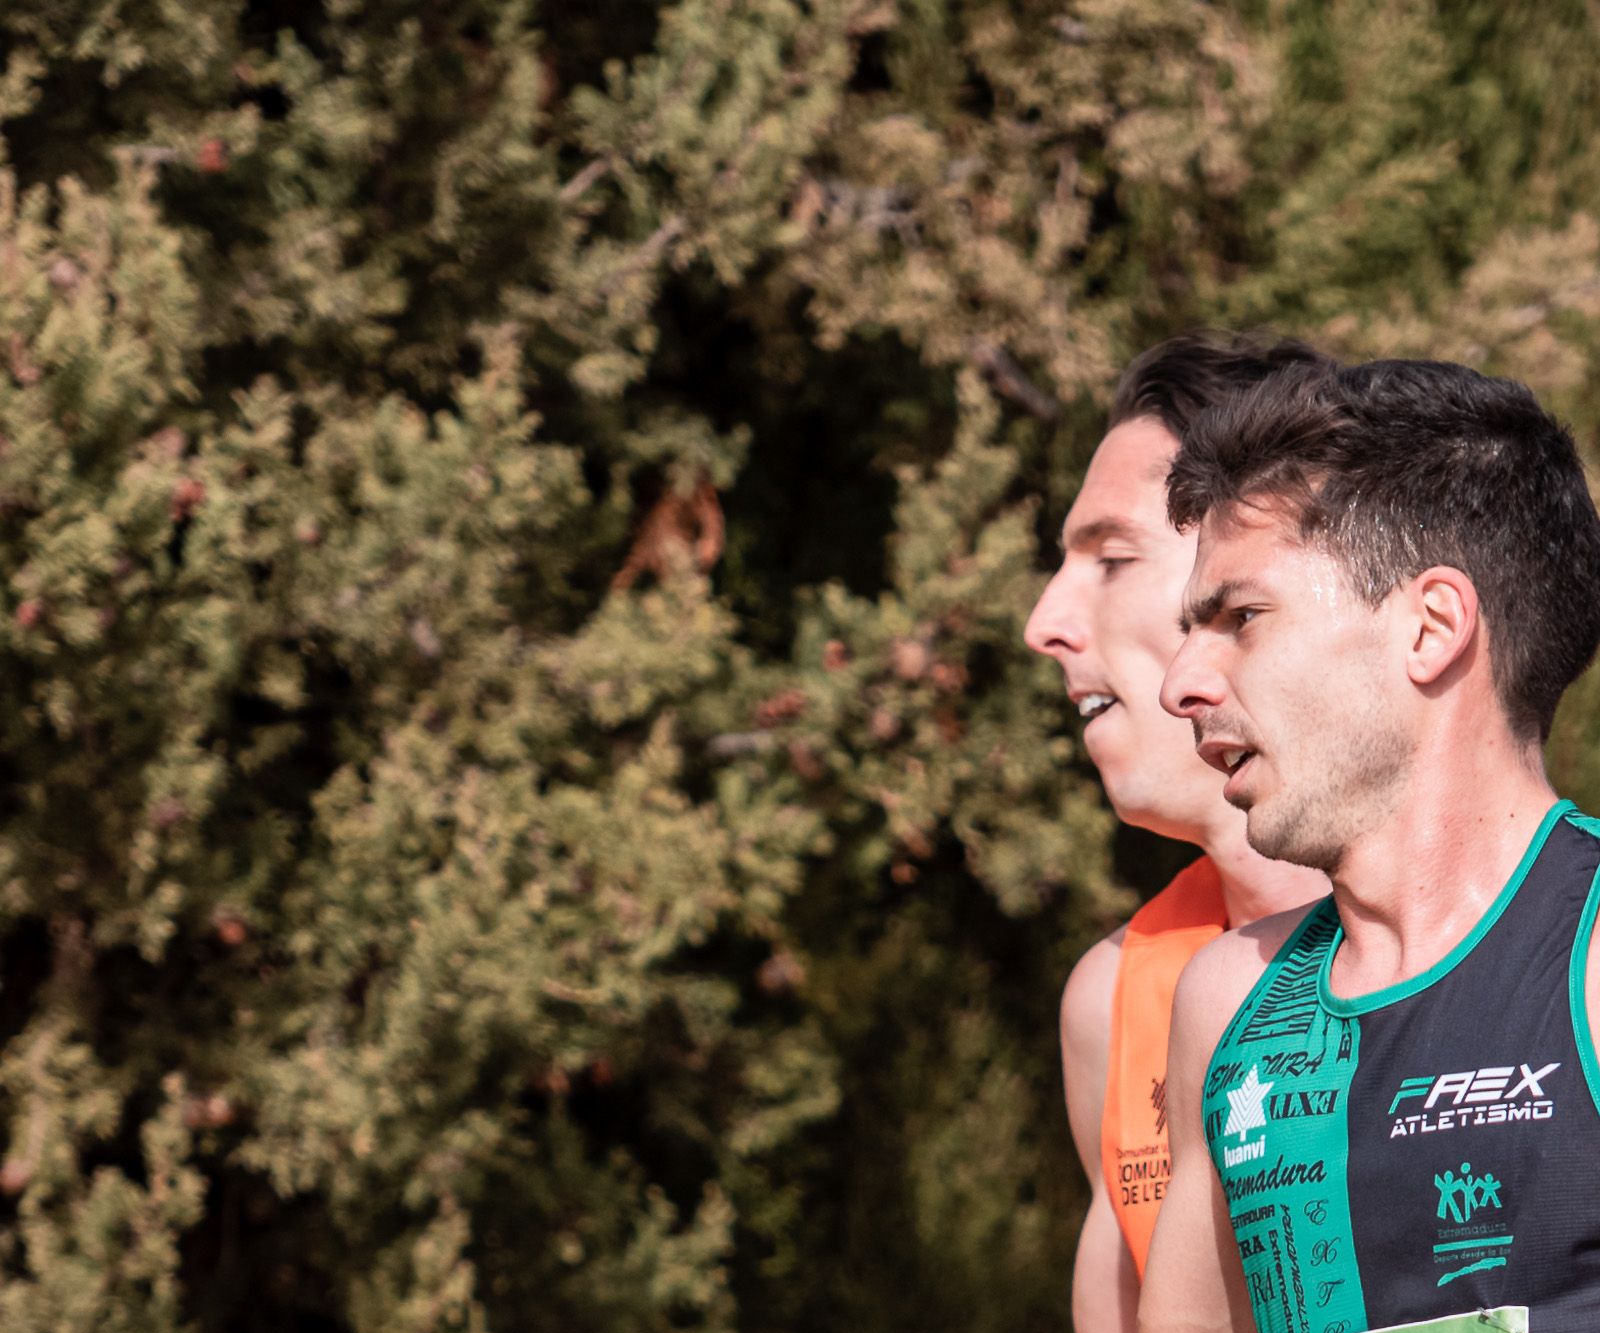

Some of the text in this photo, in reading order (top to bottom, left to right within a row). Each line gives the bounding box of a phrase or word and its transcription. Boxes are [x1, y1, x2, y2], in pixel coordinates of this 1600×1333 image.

[1388, 1063, 1562, 1115] FAEX
[1390, 1100, 1554, 1139] ATLETISMO
[1223, 1134, 1266, 1169] luanvi
